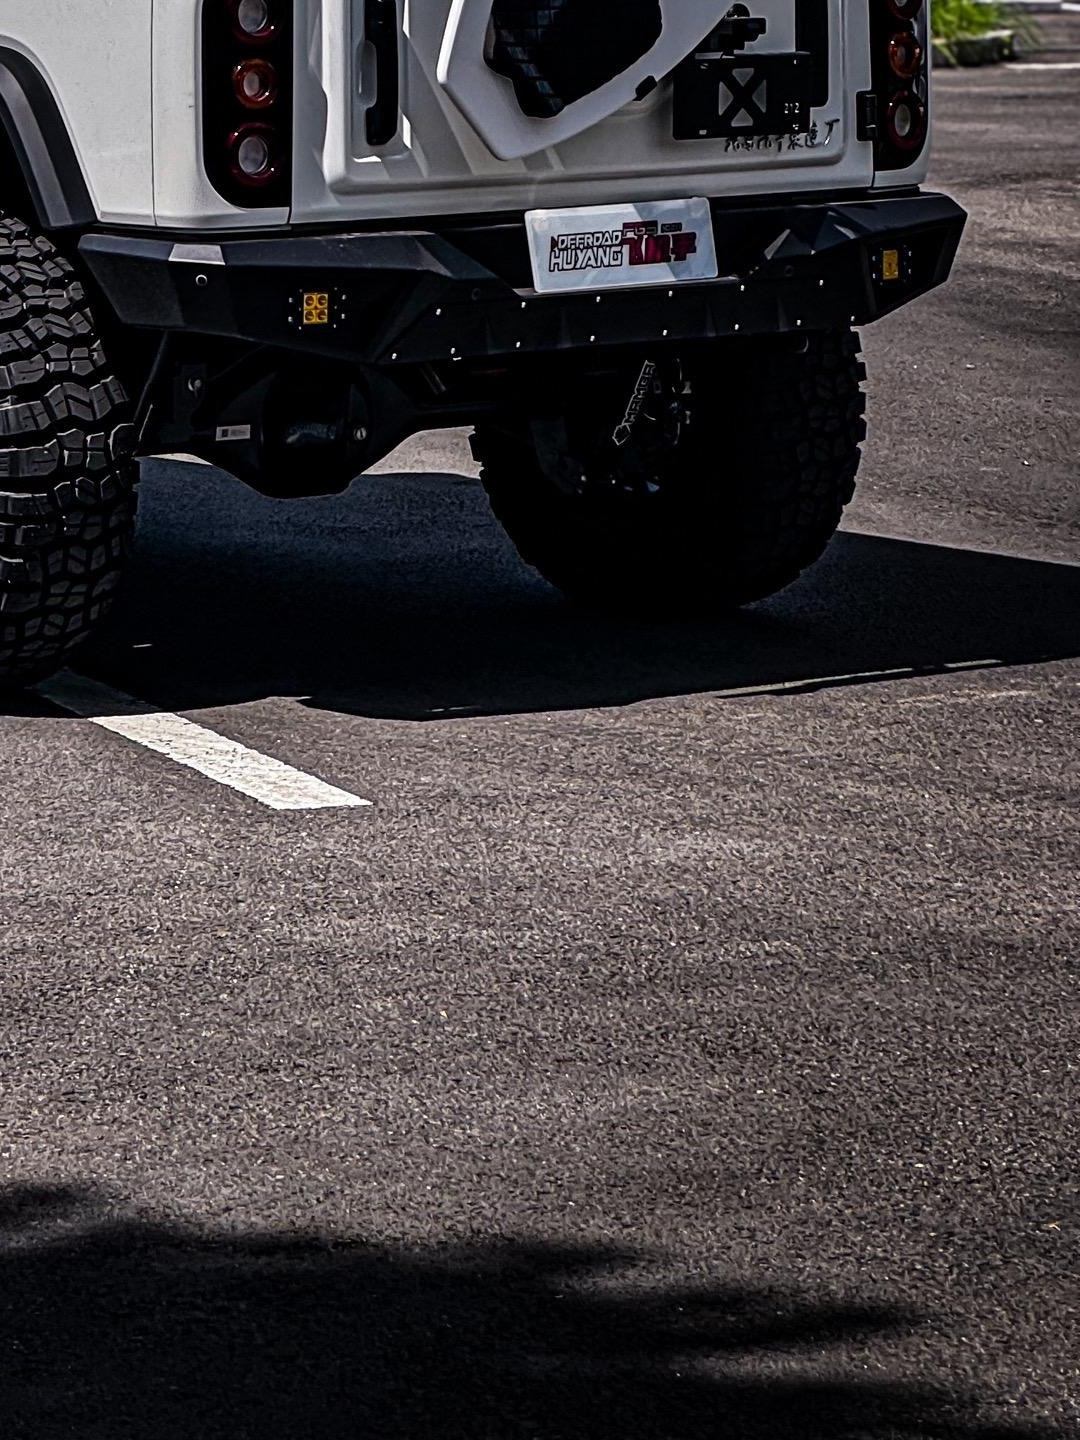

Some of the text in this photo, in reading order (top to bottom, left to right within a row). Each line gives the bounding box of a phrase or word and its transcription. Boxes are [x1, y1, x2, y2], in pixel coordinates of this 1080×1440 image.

[784, 102, 800, 114] 212
[557, 230, 622, 249] OFFROAD
[549, 246, 623, 272] HUYANG
